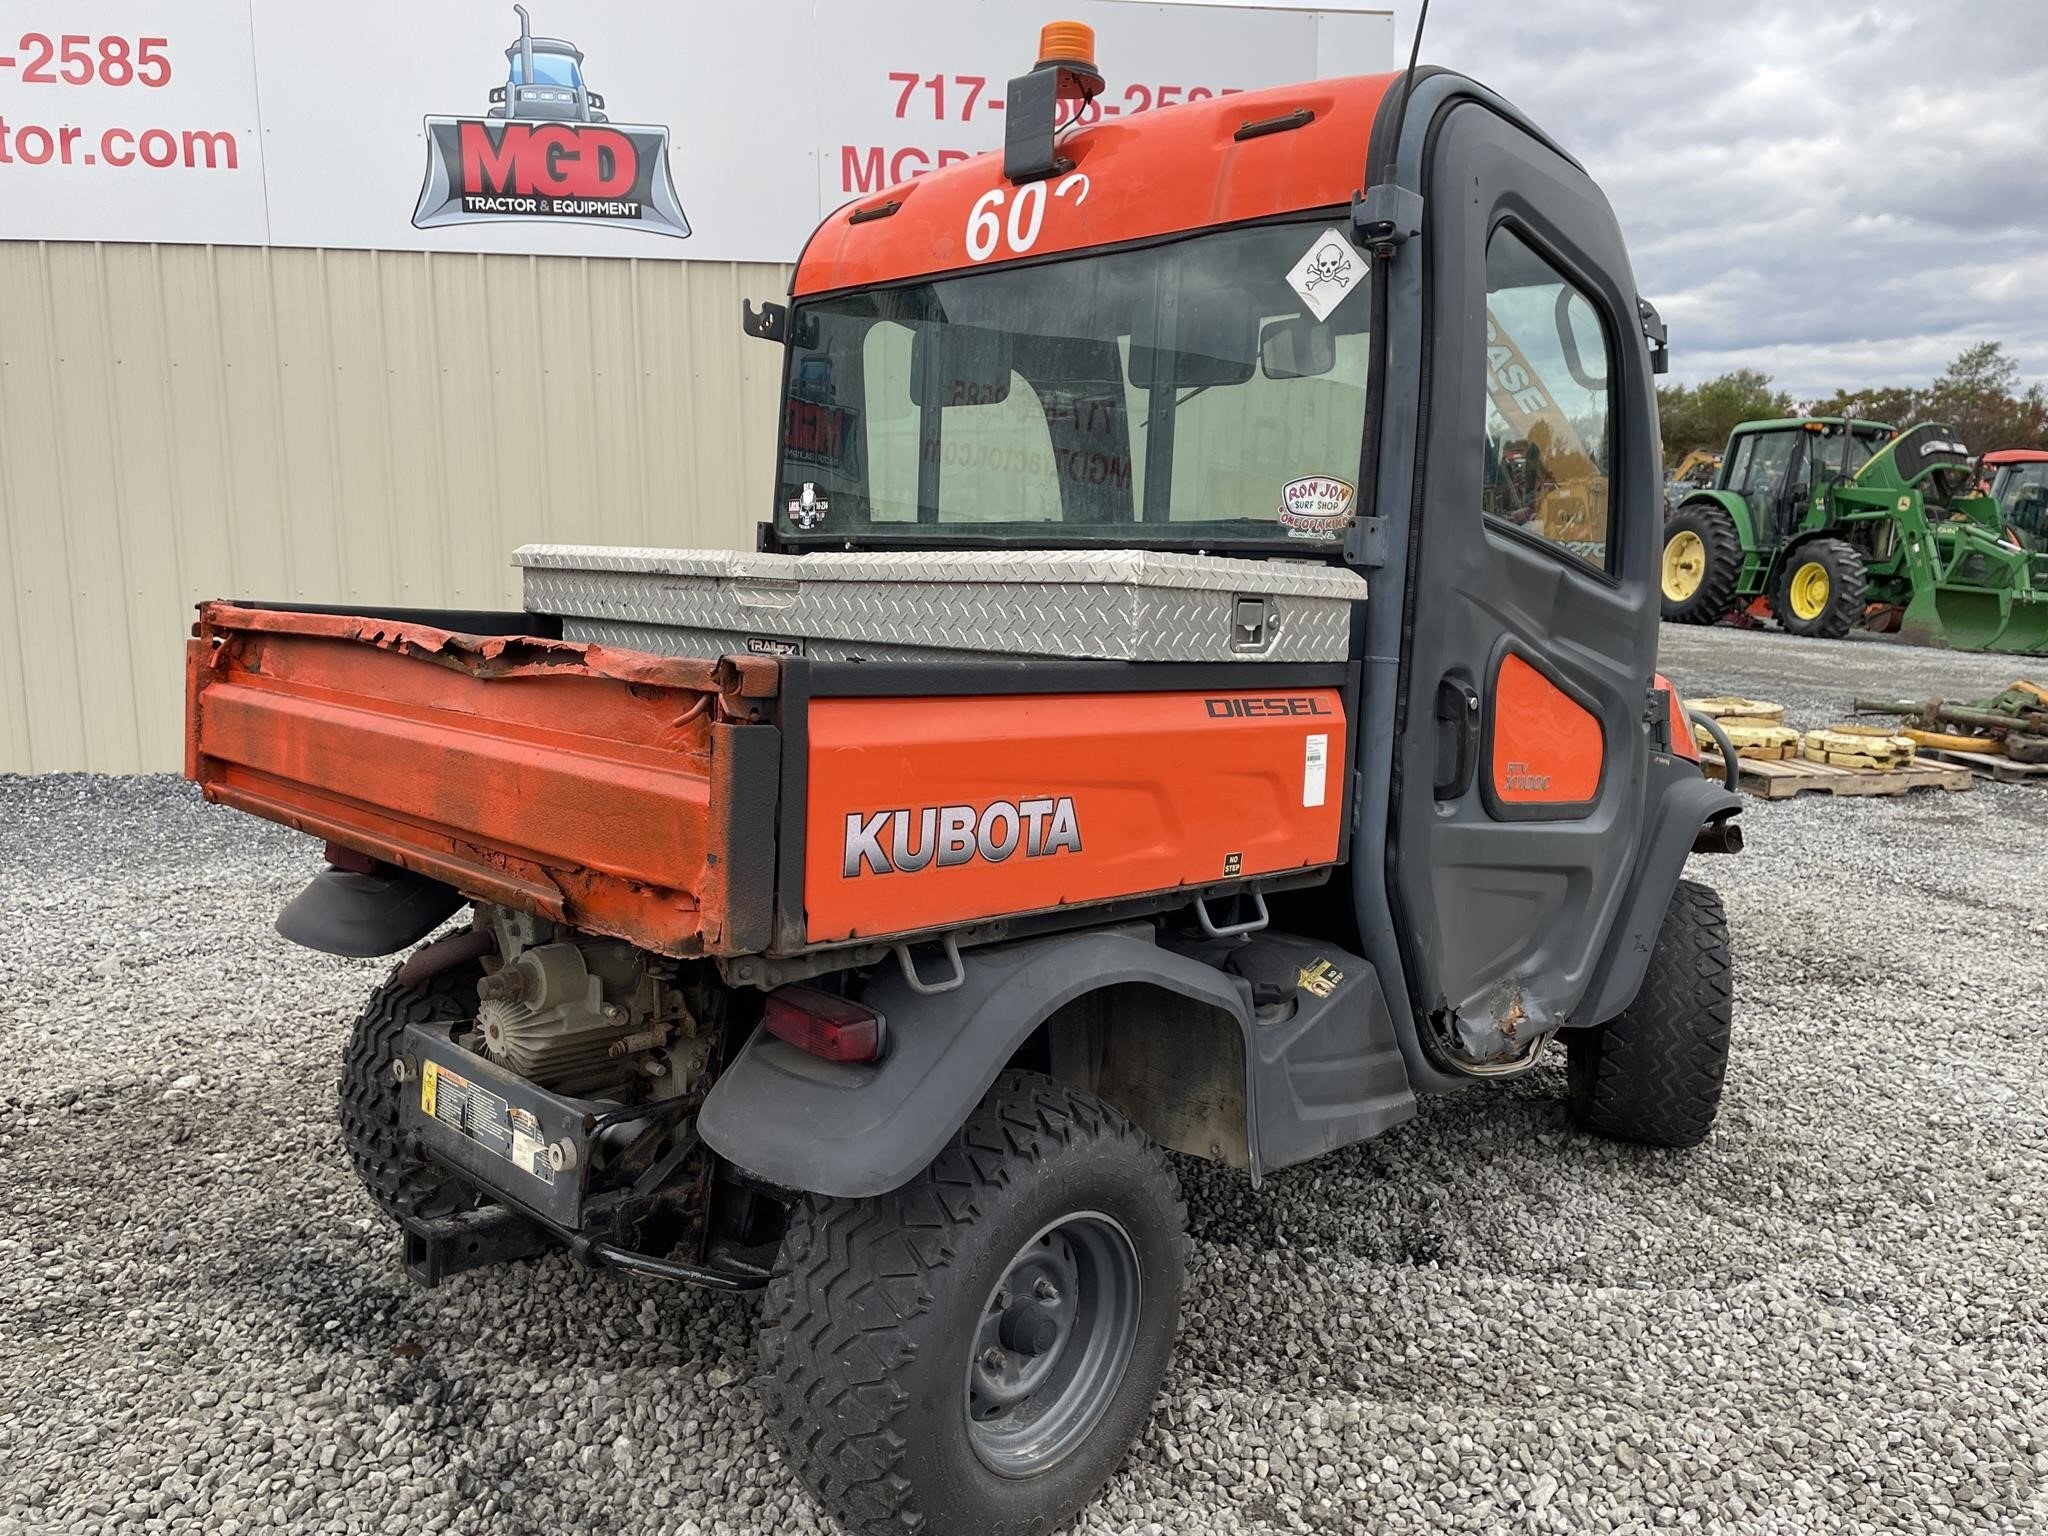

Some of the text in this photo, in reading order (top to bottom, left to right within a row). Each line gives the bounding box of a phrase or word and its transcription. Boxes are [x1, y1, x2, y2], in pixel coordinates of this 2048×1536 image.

[459, 121, 637, 198] MGD
[465, 196, 638, 216] TRACTOR & EQUIPMENT
[1288, 482, 1350, 502] RON JON
[1294, 500, 1339, 511] SURF SHOP
[1301, 518, 1315, 529] OF
[1316, 519, 1325, 530] A
[1205, 698, 1332, 718] DIESEL
[842, 796, 1083, 878] KUBOTA
[1225, 863, 1240, 873] STEP
[1229, 855, 1239, 864] NO
